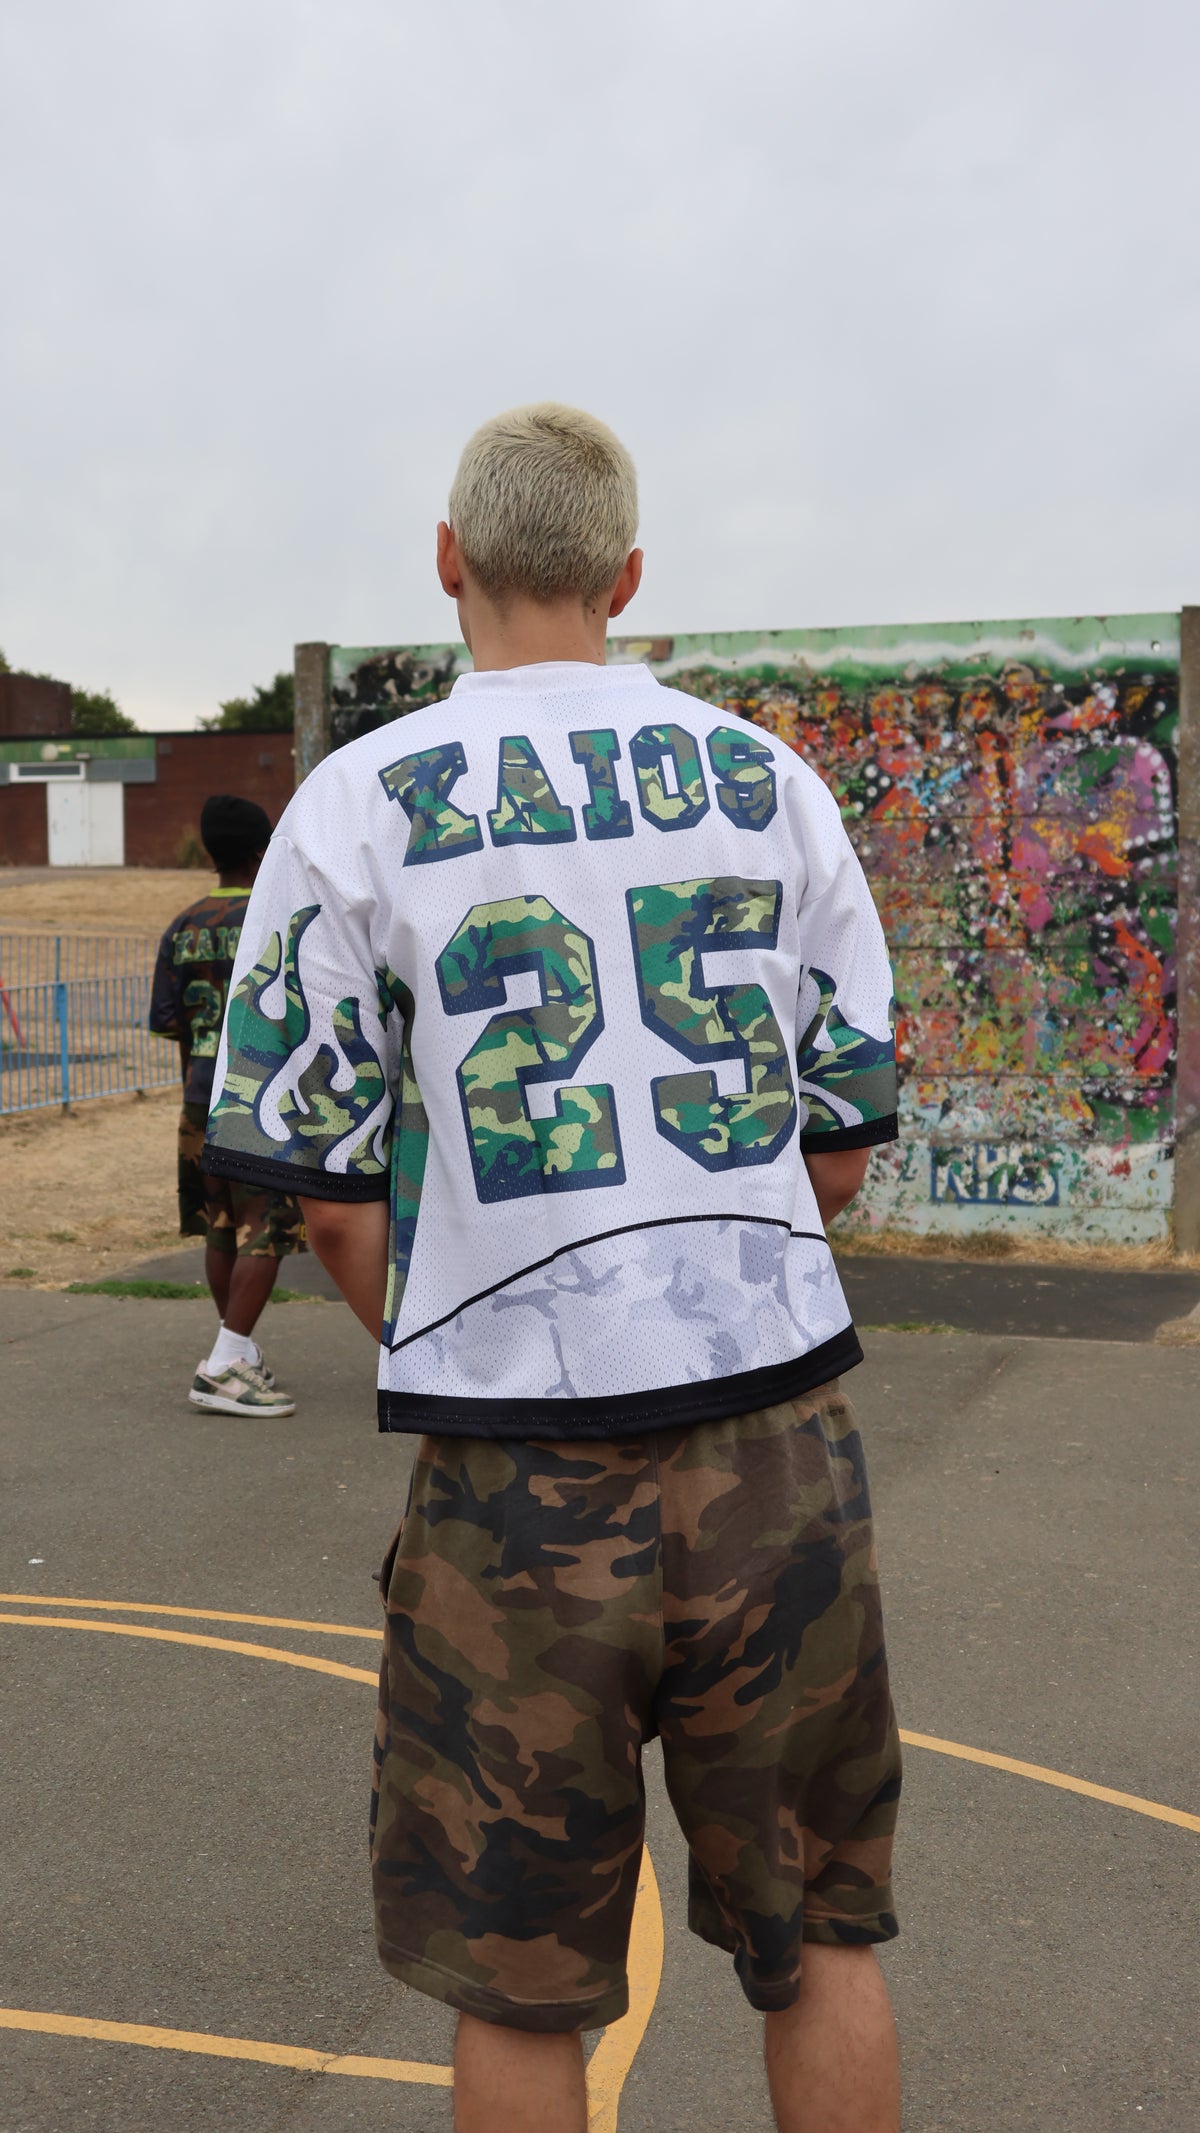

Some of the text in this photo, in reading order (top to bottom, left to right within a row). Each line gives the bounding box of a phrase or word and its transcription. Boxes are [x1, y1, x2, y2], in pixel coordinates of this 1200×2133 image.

[378, 723, 779, 867] KAIOS
[183, 979, 230, 1057] 2
[434, 876, 798, 1204] 25
[936, 1142, 1056, 1201] NHS
